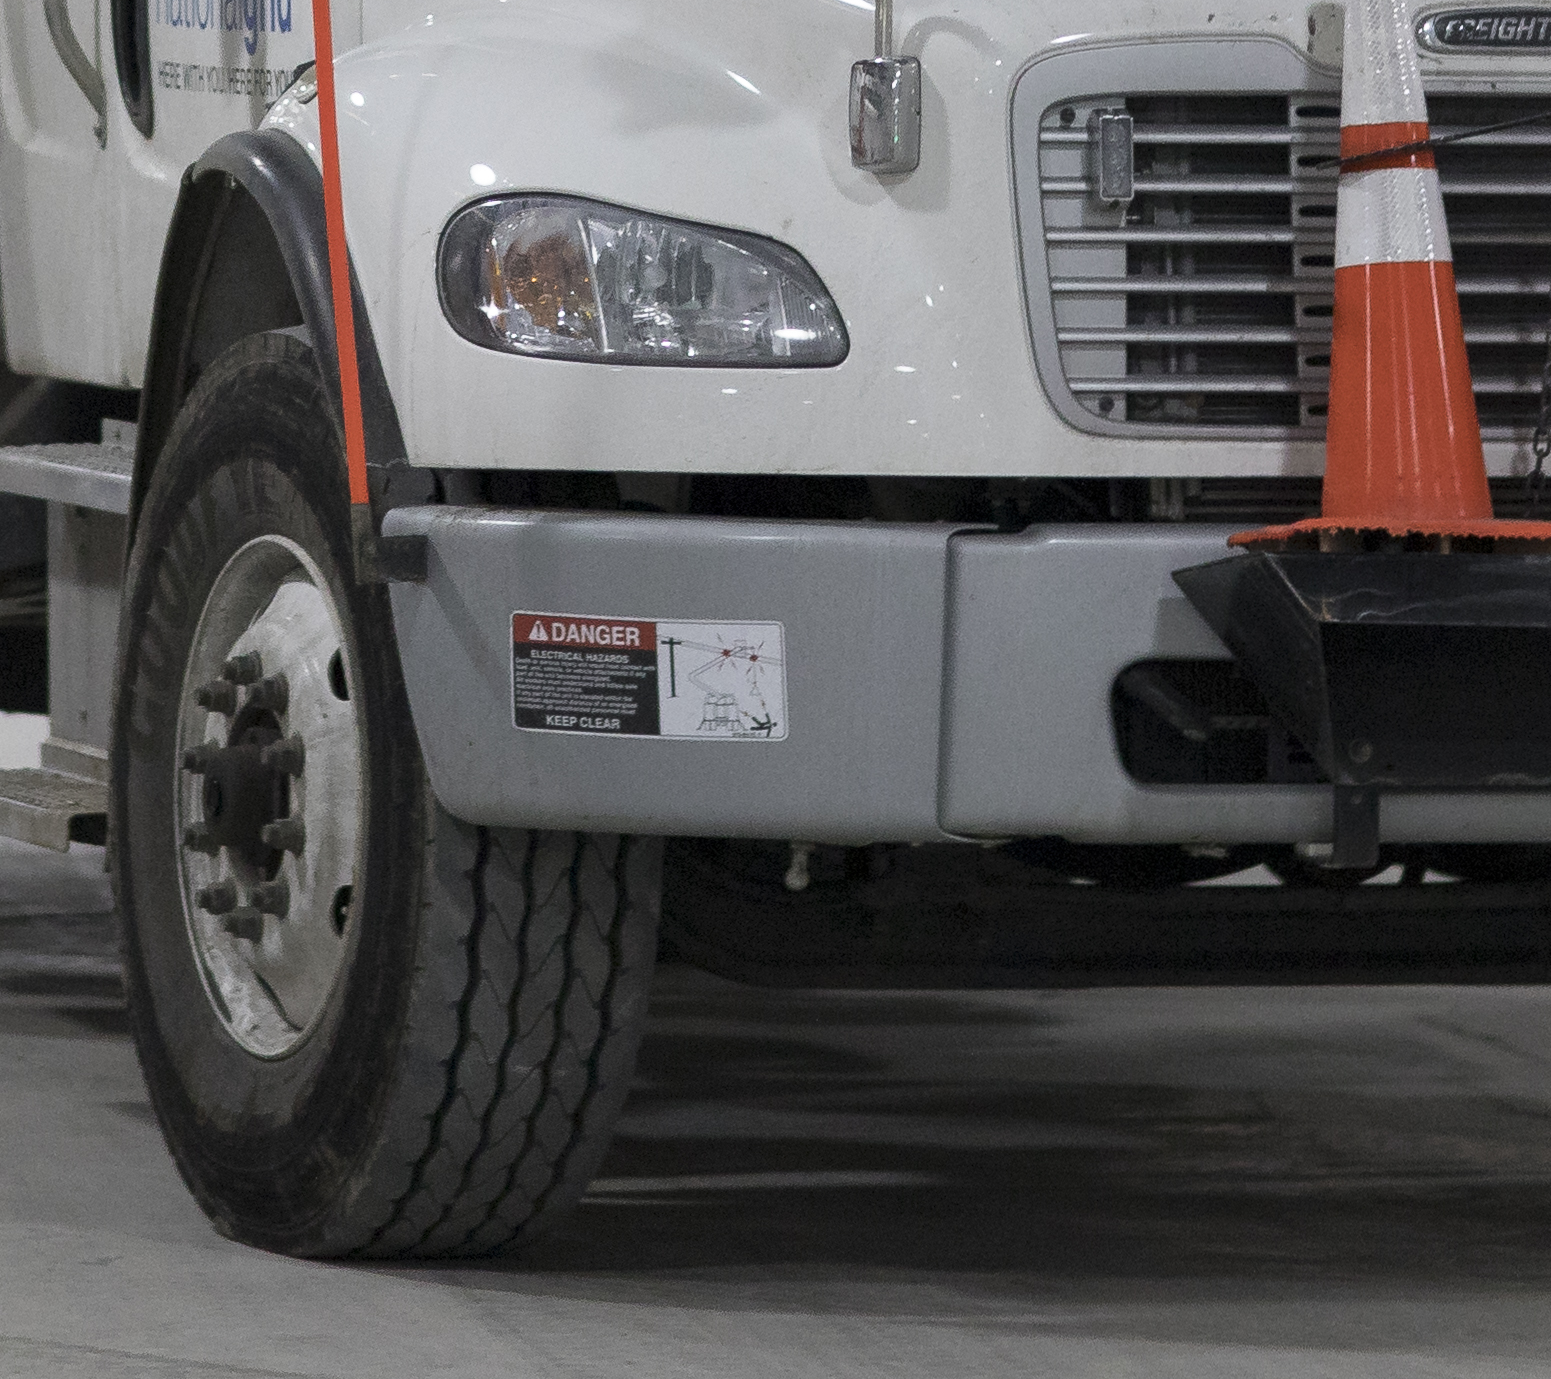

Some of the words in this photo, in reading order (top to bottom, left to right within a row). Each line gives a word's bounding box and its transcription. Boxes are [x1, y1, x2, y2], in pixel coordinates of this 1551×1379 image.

[551, 622, 641, 647] DANGER
[530, 649, 584, 661] ELECTRICAL
[585, 653, 630, 664] HAZARDS
[546, 714, 578, 727] KEEP
[579, 716, 621, 730] CLEAR
